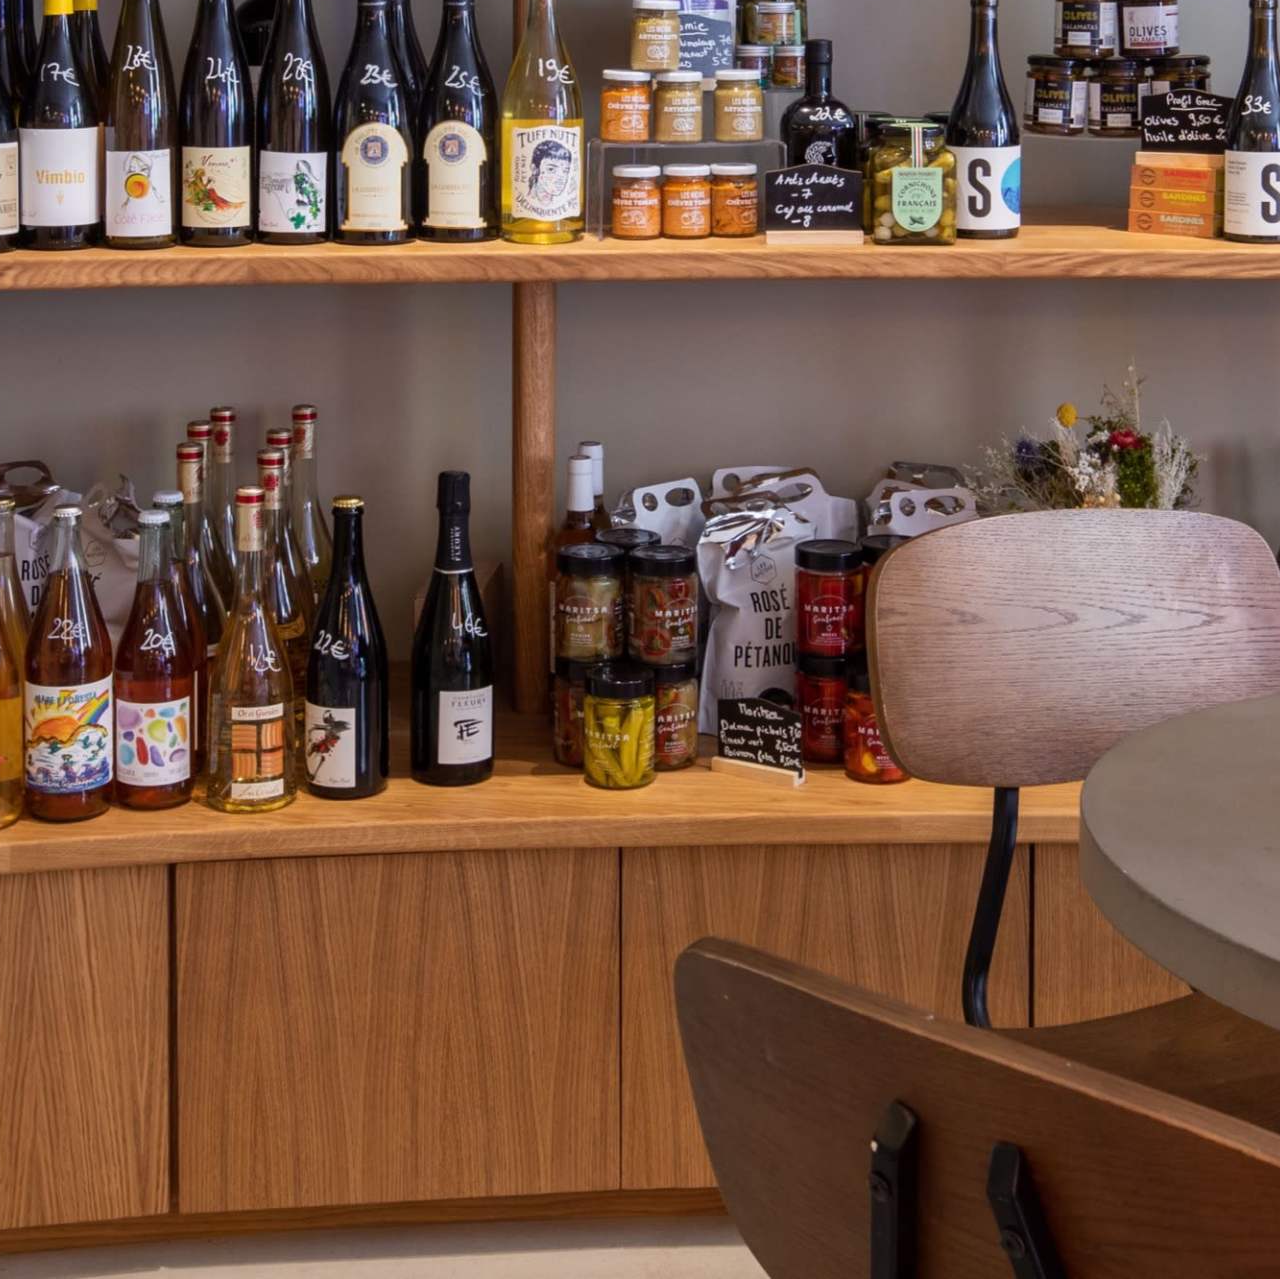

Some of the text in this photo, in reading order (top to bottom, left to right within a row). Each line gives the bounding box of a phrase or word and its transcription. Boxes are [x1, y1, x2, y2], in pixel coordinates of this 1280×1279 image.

[1063, 10, 1098, 21] OLIVES
[1129, 25, 1168, 37] OLIVES
[40, 63, 80, 87] 17€
[444, 65, 486, 97] 25€
[537, 58, 574, 85] 19€
[1036, 89, 1070, 99] OLIVES
[1101, 93, 1136, 103] OLIVES
[1144, 116, 1180, 126] olives
[1144, 128, 1213, 142] huile d'olive
[35, 169, 86, 185] Vimbio
[967, 158, 992, 218] S
[454, 525, 462, 562] FLEURY
[750, 583, 791, 614] ROSÉ
[451, 612, 489, 638] 46€
[764, 617, 783, 640] DE
[140, 628, 177, 656] 20€
[315, 629, 351, 661] 22€
[451, 696, 487, 708] FLEURY
